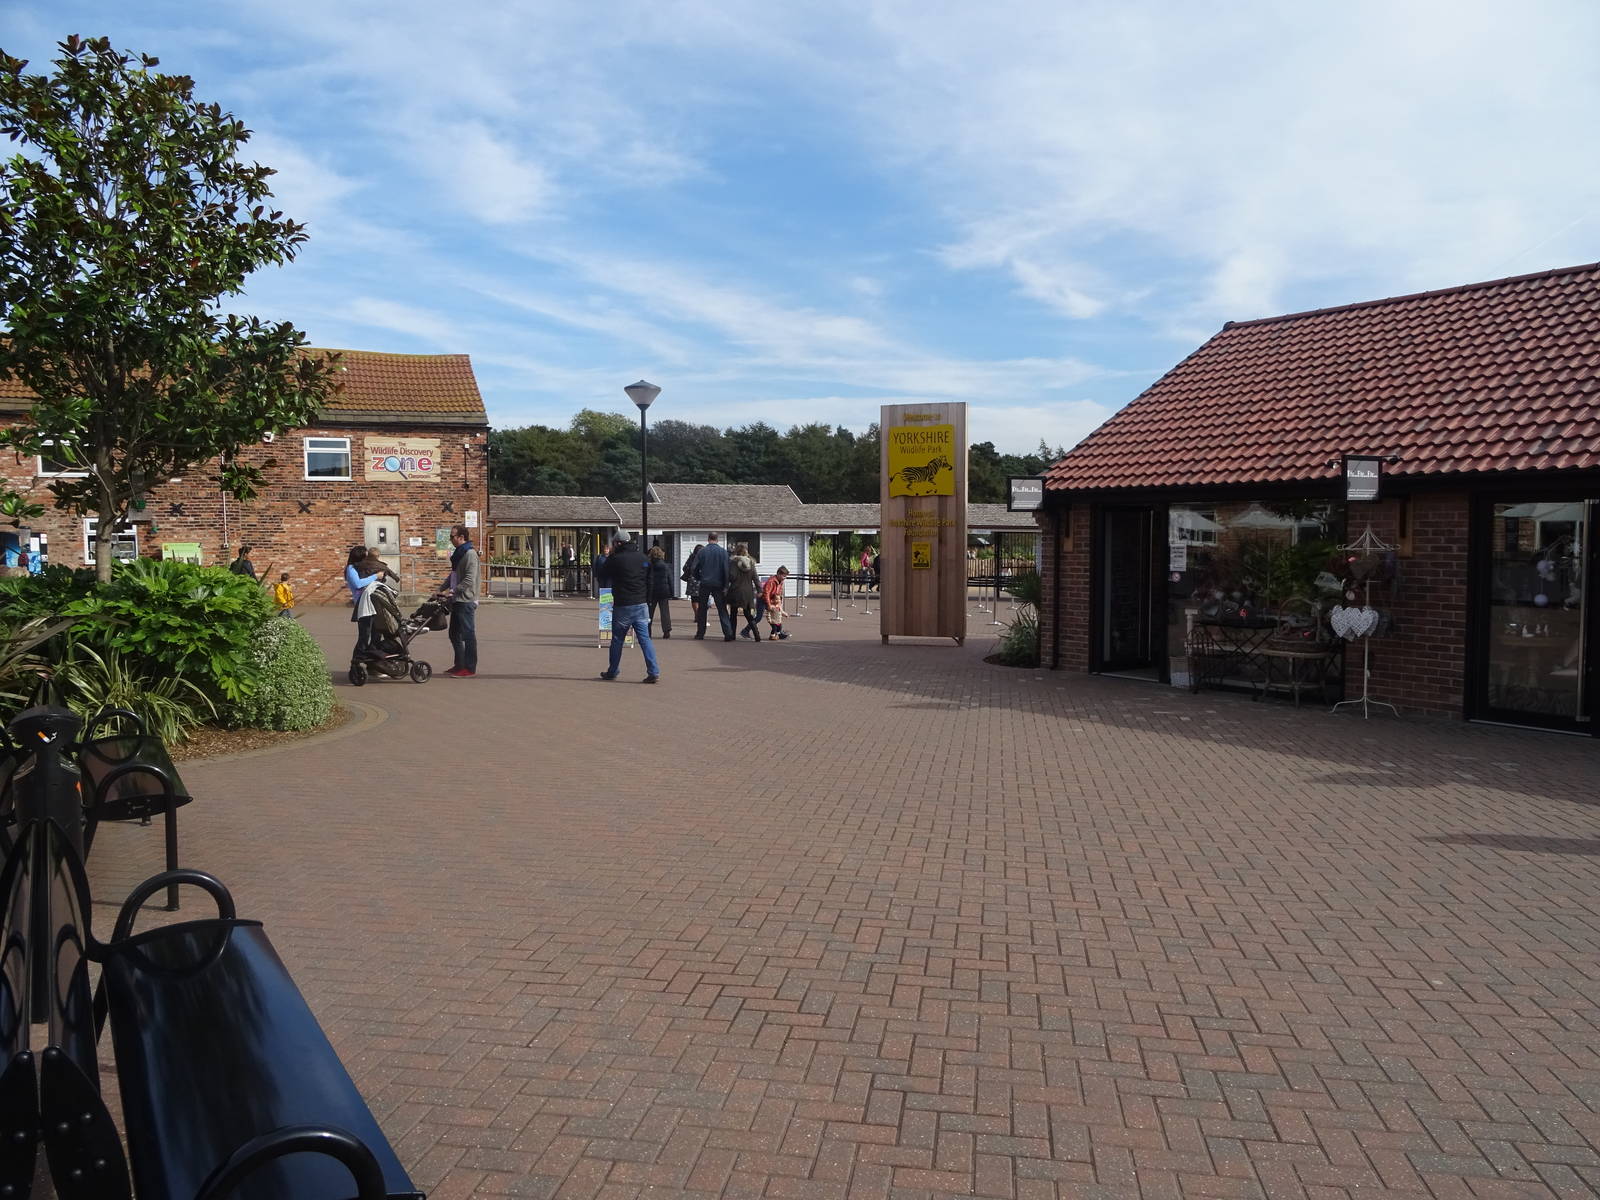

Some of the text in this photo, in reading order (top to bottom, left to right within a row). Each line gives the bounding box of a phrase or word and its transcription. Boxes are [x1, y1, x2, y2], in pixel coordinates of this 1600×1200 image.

[893, 431, 950, 444] YORKSHIRE
[370, 446, 433, 457] Wildlife Discovery
[900, 444, 942, 454] Wildlife Park
